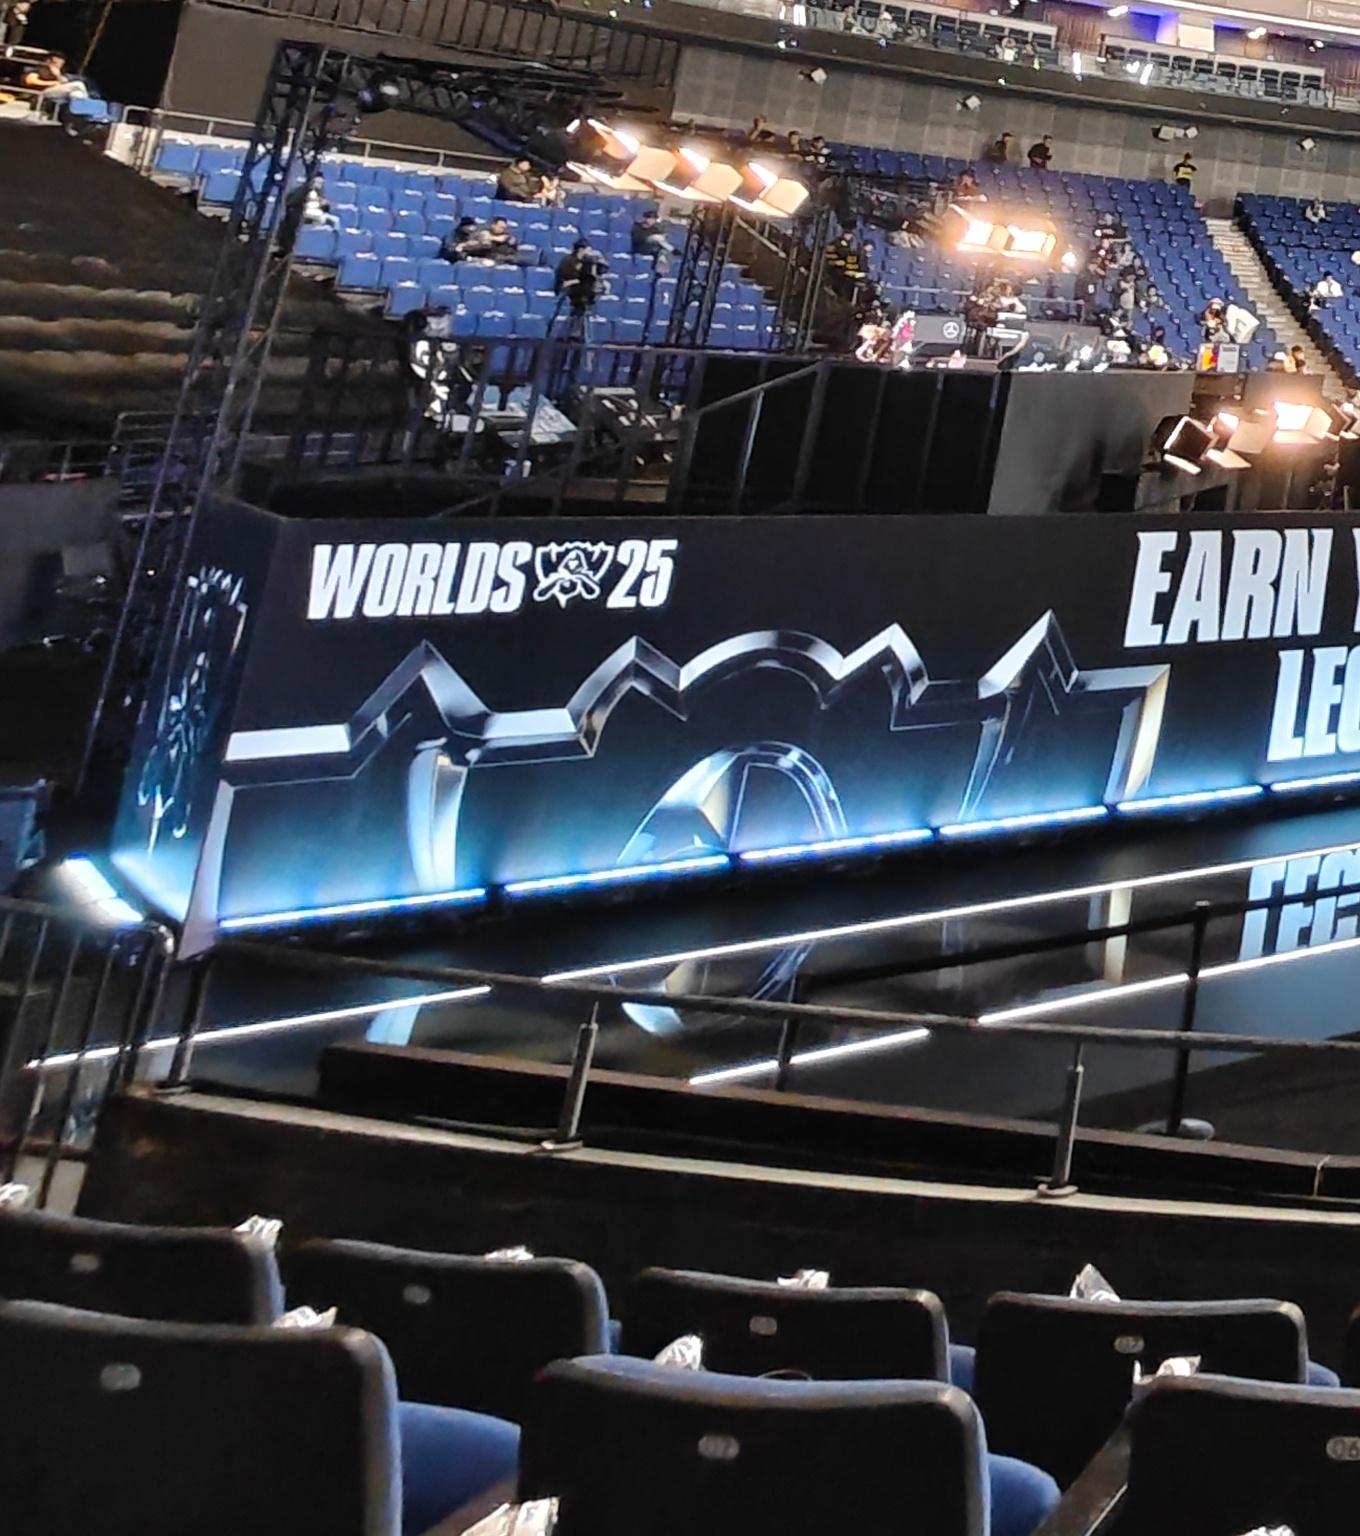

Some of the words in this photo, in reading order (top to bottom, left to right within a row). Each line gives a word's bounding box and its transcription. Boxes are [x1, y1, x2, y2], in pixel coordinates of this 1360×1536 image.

[306, 541, 533, 620] WORLDS
[606, 539, 679, 609] 25
[1124, 529, 1333, 647] EARN
